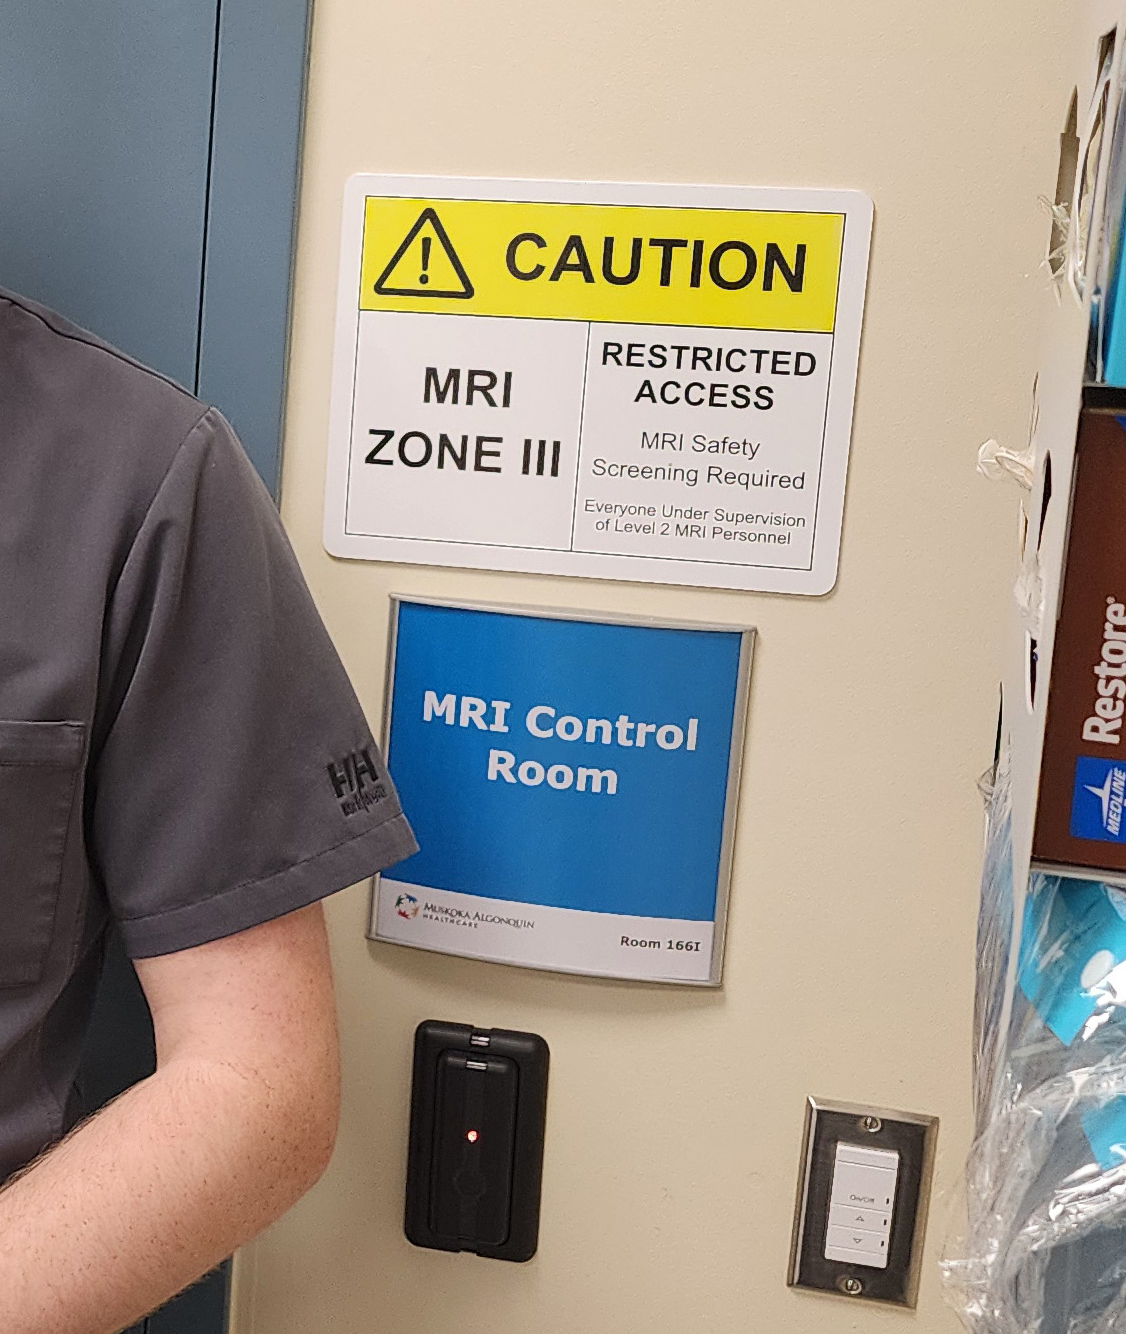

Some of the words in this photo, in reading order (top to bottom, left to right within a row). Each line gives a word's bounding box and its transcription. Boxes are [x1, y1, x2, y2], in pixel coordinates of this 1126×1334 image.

[505, 232, 807, 293] CAUTION
[601, 341, 817, 377] RESTRICTED
[423, 367, 512, 408] MRI
[634, 379, 774, 411] ACCESS
[365, 429, 503, 473] ZONE
[522, 439, 562, 477] III
[641, 431, 684, 451] MRI
[691, 434, 761, 460] Safety
[592, 458, 698, 487] Screening
[706, 466, 806, 490] Required
[584, 499, 657, 517] Everyone
[662, 504, 710, 520] Under
[713, 508, 806, 528] Supervision
[595, 519, 611, 531] of
[615, 519, 655, 535] Level
[660, 522, 670, 536] 2
[675, 524, 706, 539] MRI
[712, 526, 792, 545] Personnel
[422, 690, 512, 733] MRI
[525, 705, 699, 751] Control
[487, 748, 619, 795] Room
[1106, 766, 1126, 837] MEDLINE
[422, 914, 479, 929] HEALTHCARE
[424, 902, 471, 920] MUSKOKA
[474, 911, 535, 929] ALGONQUIN
[620, 935, 661, 949] Room
